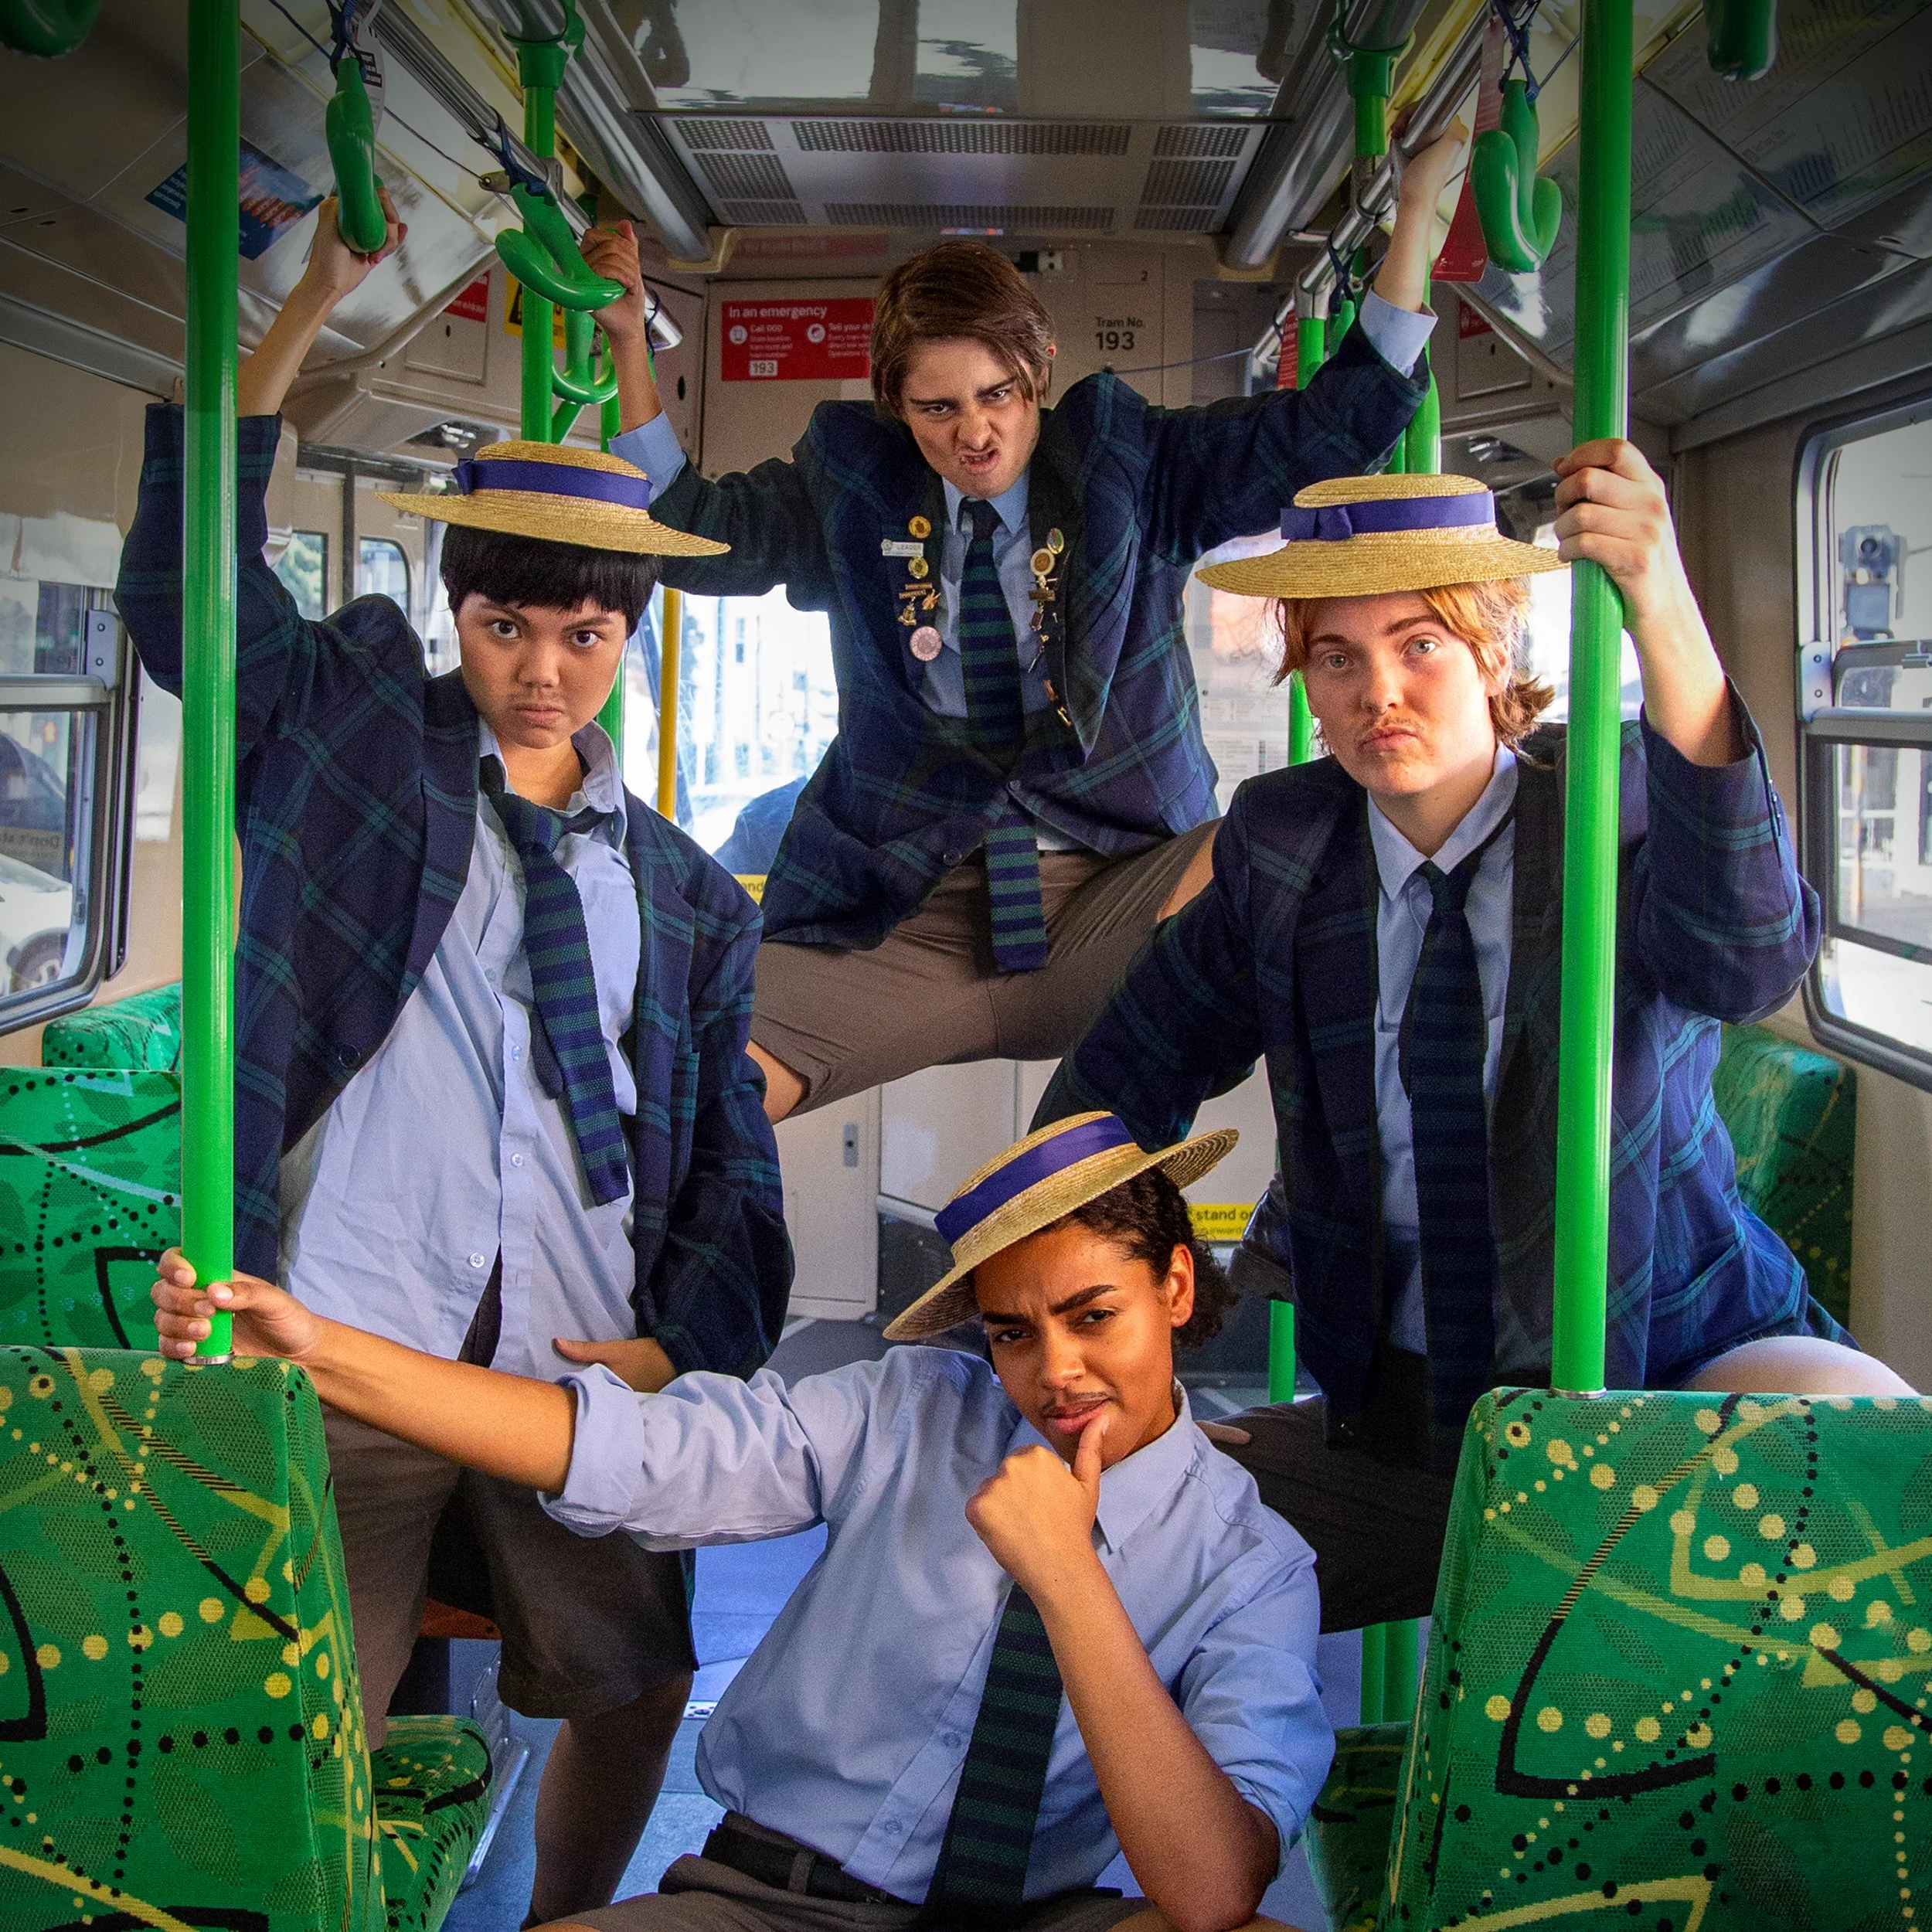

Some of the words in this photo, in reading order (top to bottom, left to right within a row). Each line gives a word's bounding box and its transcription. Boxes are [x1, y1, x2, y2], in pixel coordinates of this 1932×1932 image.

[1141, 270, 1148, 281] 2
[729, 307, 740, 318] In
[743, 308, 757, 318] an
[760, 306, 828, 320] emergency
[1094, 316, 1124, 328] Tram
[1095, 331, 1134, 350] 193
[752, 362, 774, 374] 193
[1196, 1209, 1236, 1220] stand
